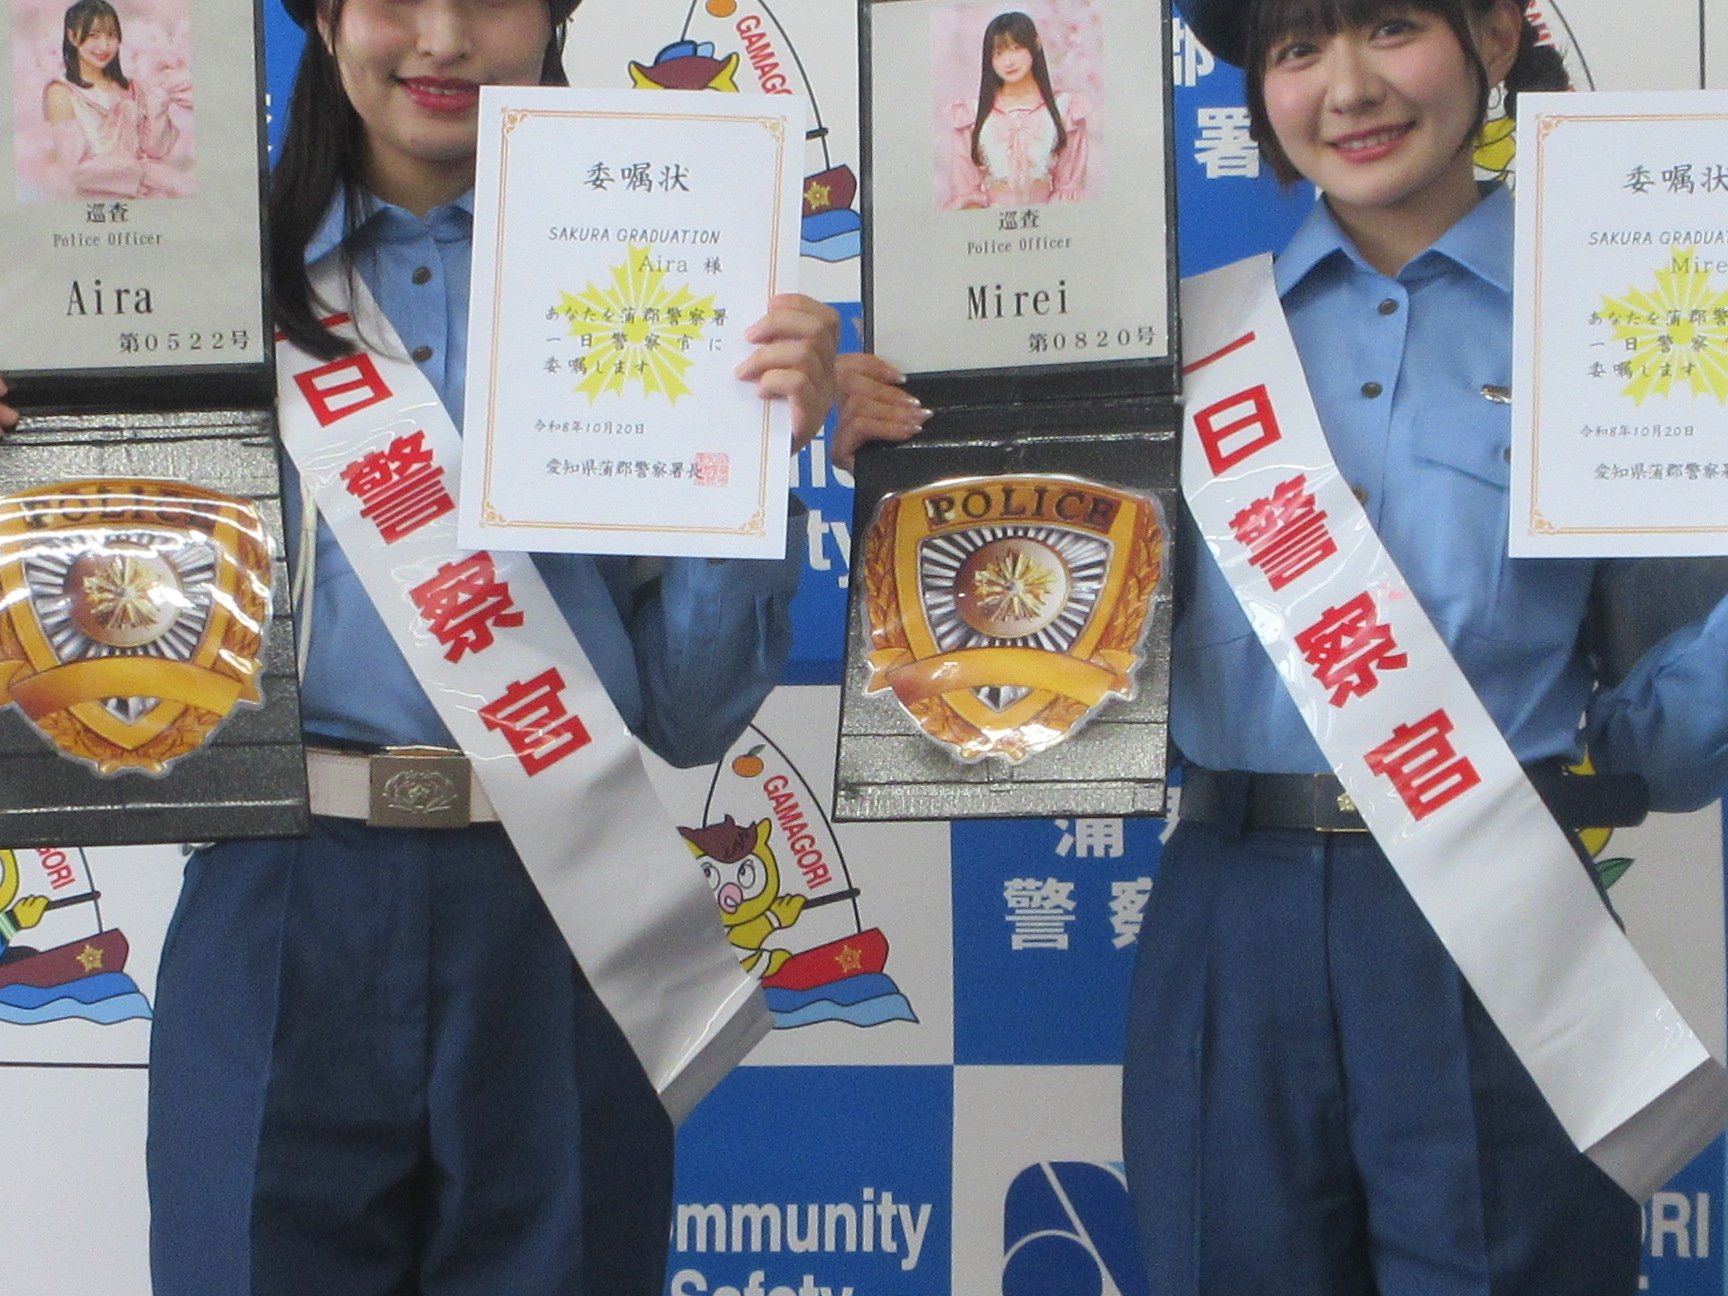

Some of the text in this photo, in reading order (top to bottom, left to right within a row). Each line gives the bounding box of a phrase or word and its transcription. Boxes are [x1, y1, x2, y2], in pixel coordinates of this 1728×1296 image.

[735, 15, 793, 95] GAMAG
[585, 162, 690, 193] 委嘱状
[85, 203, 129, 224] 巡査
[998, 209, 1040, 231] 巡査
[53, 230, 162, 248] Police Officer
[549, 226, 721, 245] SAKURA GRADUATION
[967, 236, 1071, 256] Police Officer
[1589, 230, 1652, 246] SAKURA
[639, 254, 723, 274] Aira 様
[67, 279, 154, 317] Aira
[967, 280, 1068, 321] Mirei
[119, 329, 250, 354] 第0522号
[1028, 326, 1156, 354] 第0820号
[926, 487, 1120, 528] POLICE
[1183, 332, 1483, 822] 一日警察官
[763, 774, 834, 889] GAMAGORI
[670, 1187, 932, 1271] mmunity
